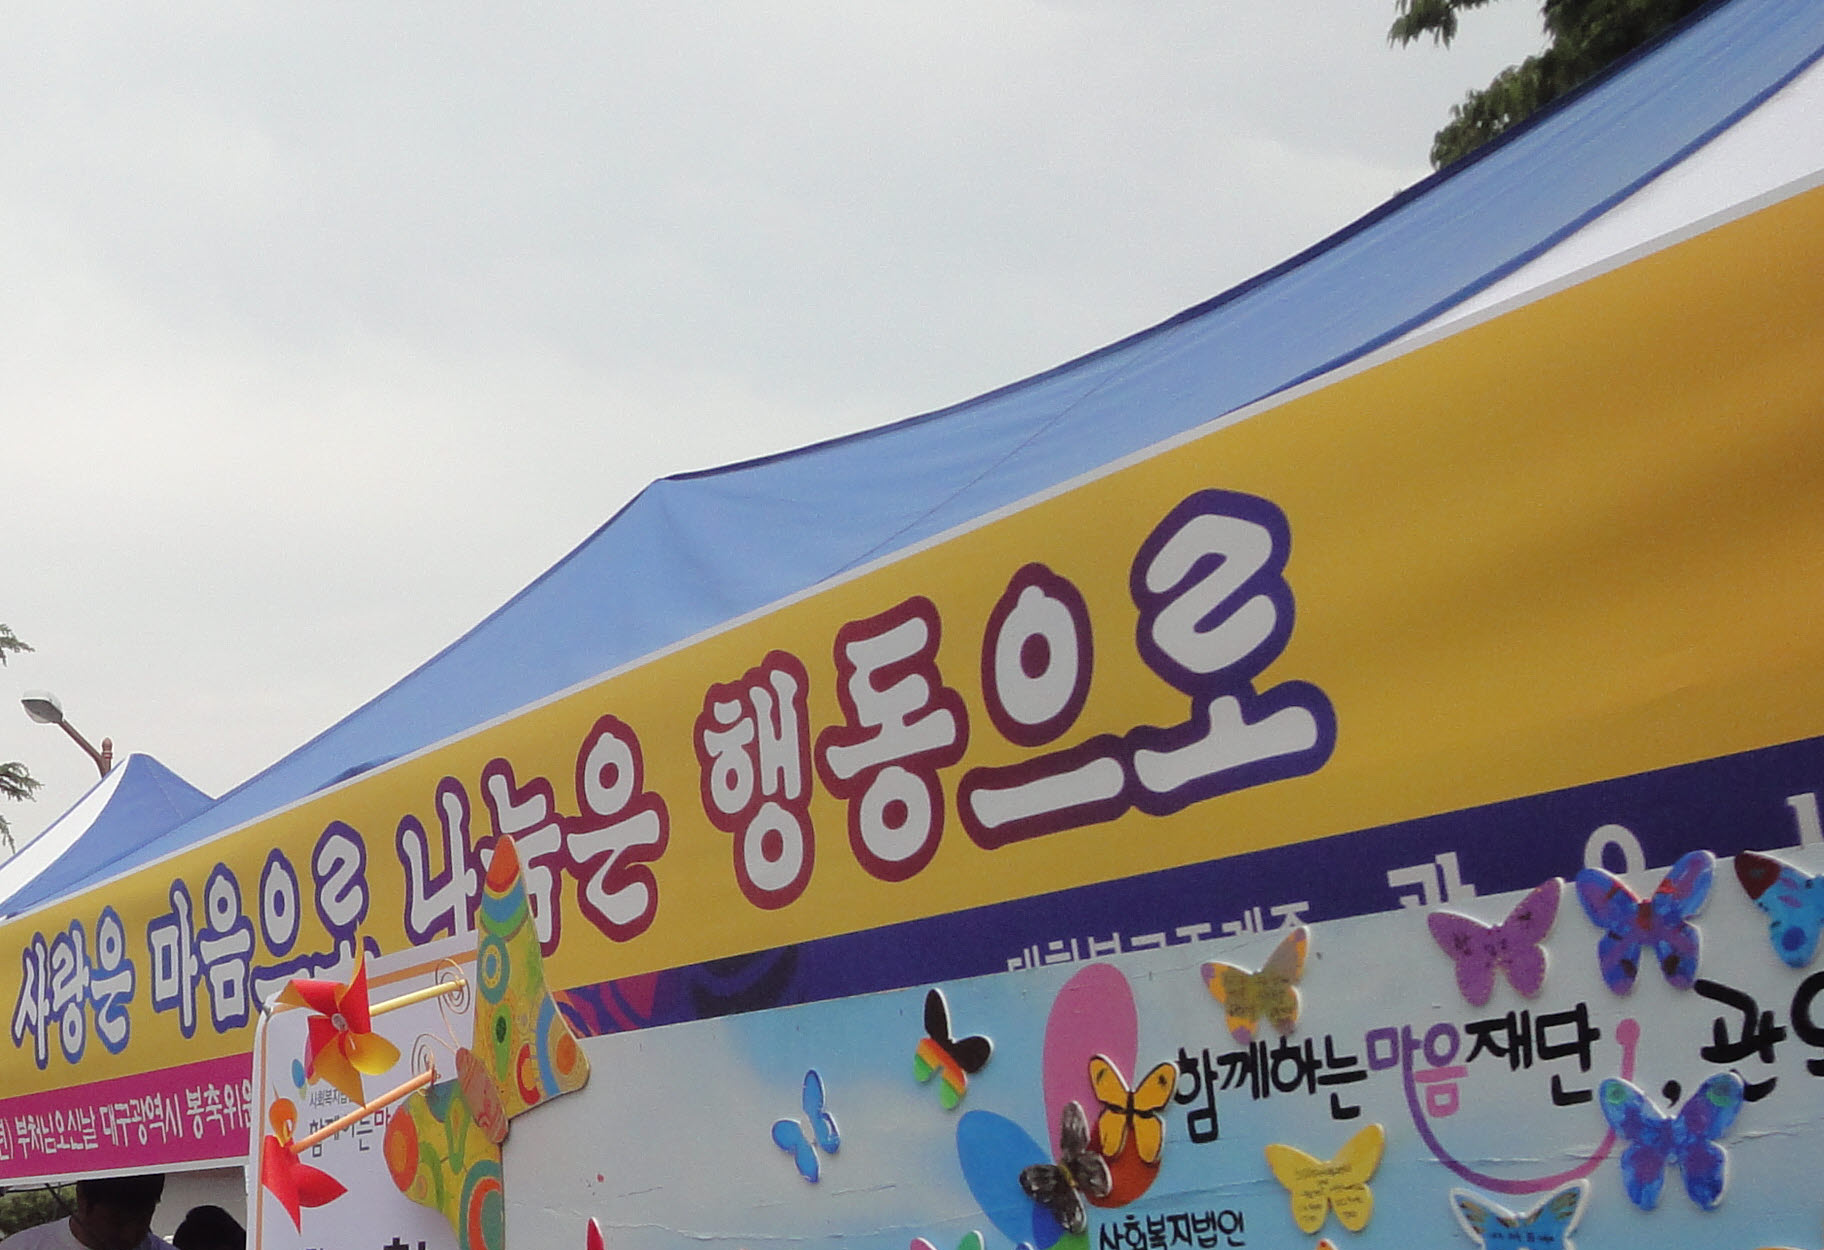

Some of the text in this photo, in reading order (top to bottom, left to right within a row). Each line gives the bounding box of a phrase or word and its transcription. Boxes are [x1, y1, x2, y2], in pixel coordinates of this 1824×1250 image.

[13, 488, 1337, 1070] 사랑은 마음으로 나눔은 행동으로
[14, 1103, 99, 1159] 부처님오신날
[99, 1092, 184, 1148] 대구광역시
[1174, 1002, 1600, 1142] 함께하는마음재단
